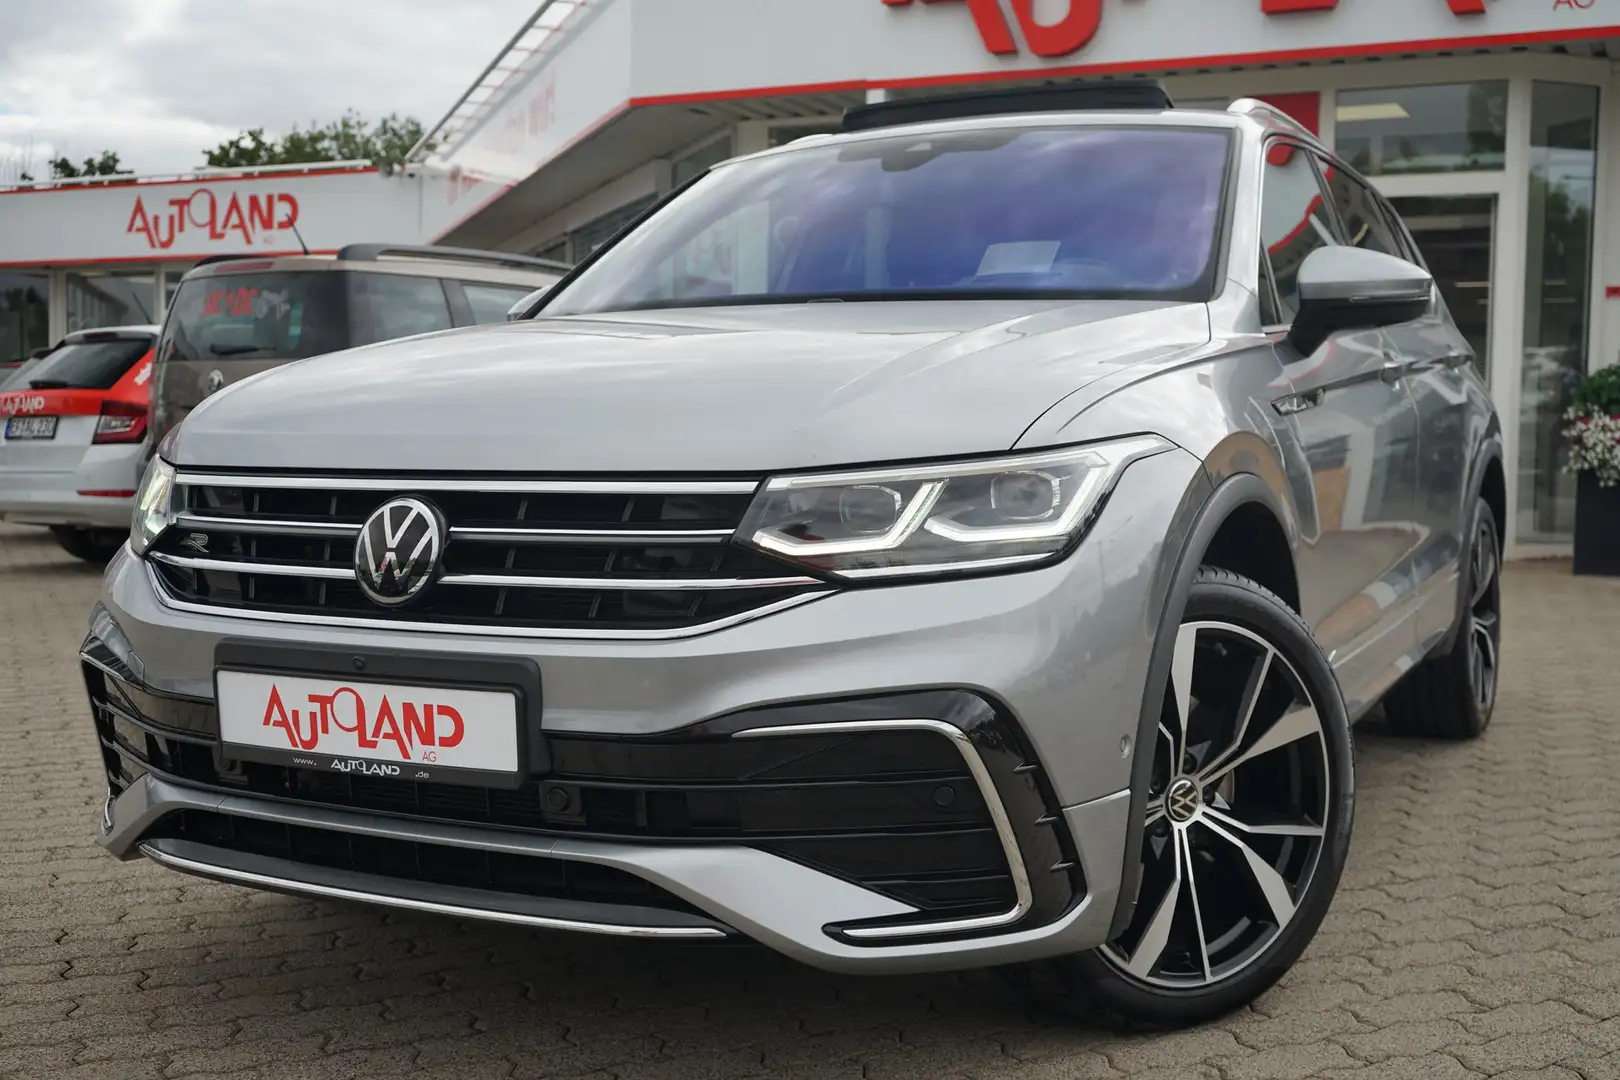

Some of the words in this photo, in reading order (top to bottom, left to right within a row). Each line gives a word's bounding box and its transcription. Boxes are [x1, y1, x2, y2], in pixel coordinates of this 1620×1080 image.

[127, 188, 299, 249] AUTOLAND
[262, 683, 465, 760] AUTOLAND
[293, 757, 317, 766] www.
[330, 759, 400, 776] AUTOLAND
[415, 771, 430, 779] .de
[422, 751, 437, 763] AG
